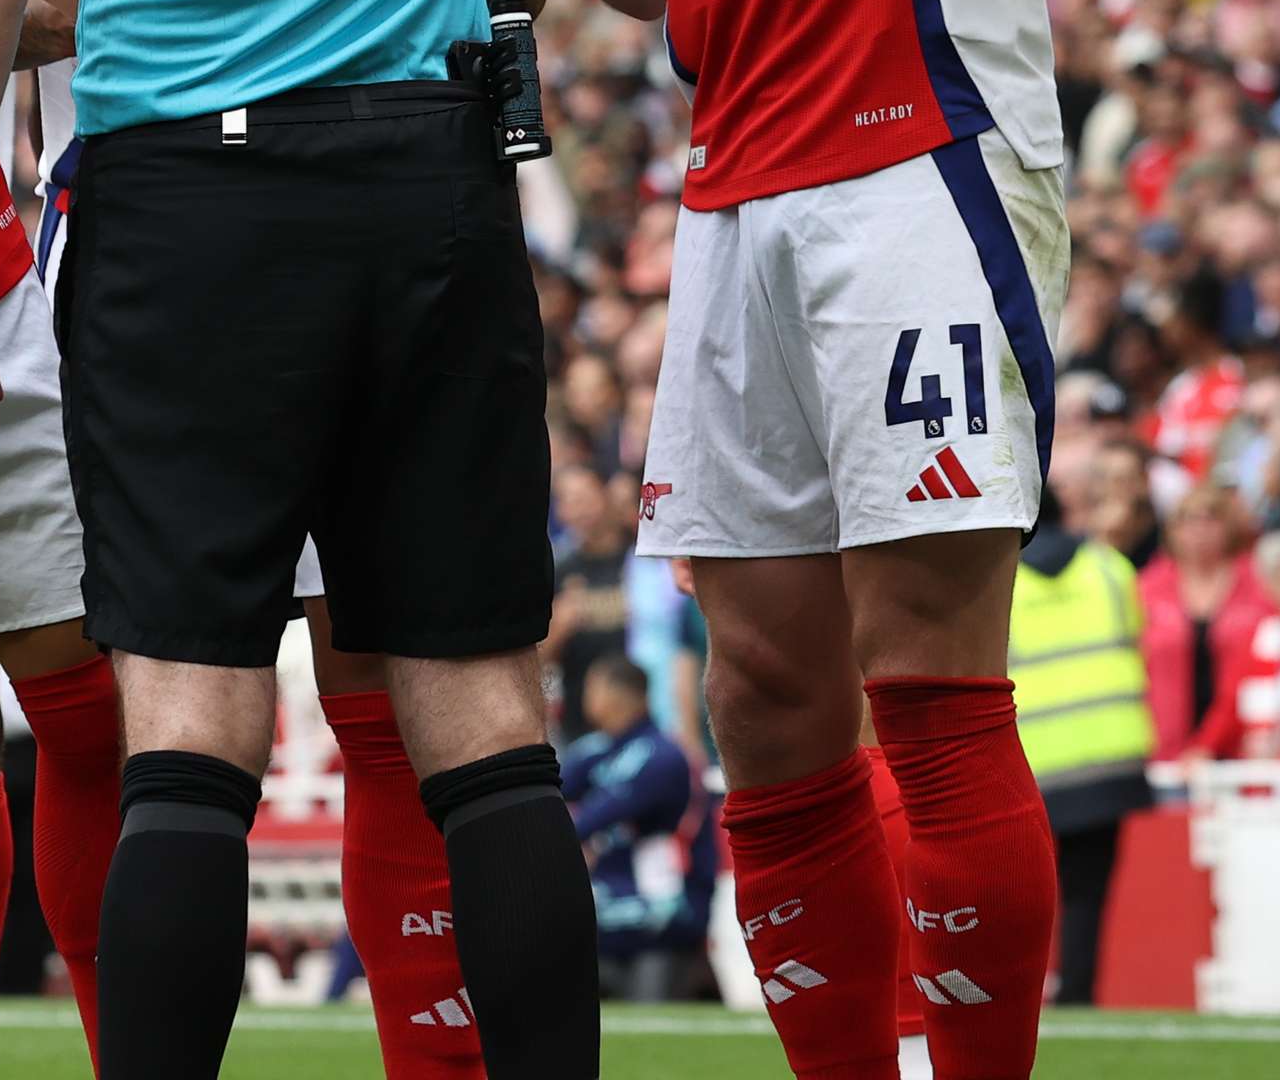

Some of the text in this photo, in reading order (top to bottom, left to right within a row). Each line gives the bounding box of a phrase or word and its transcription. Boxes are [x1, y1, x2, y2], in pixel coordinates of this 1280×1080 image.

[855, 103, 913, 127] HEAT.RDY
[884, 323, 988, 439] 41
[401, 910, 454, 936] AF
[742, 898, 803, 941] FC
[907, 897, 979, 934] AFC
